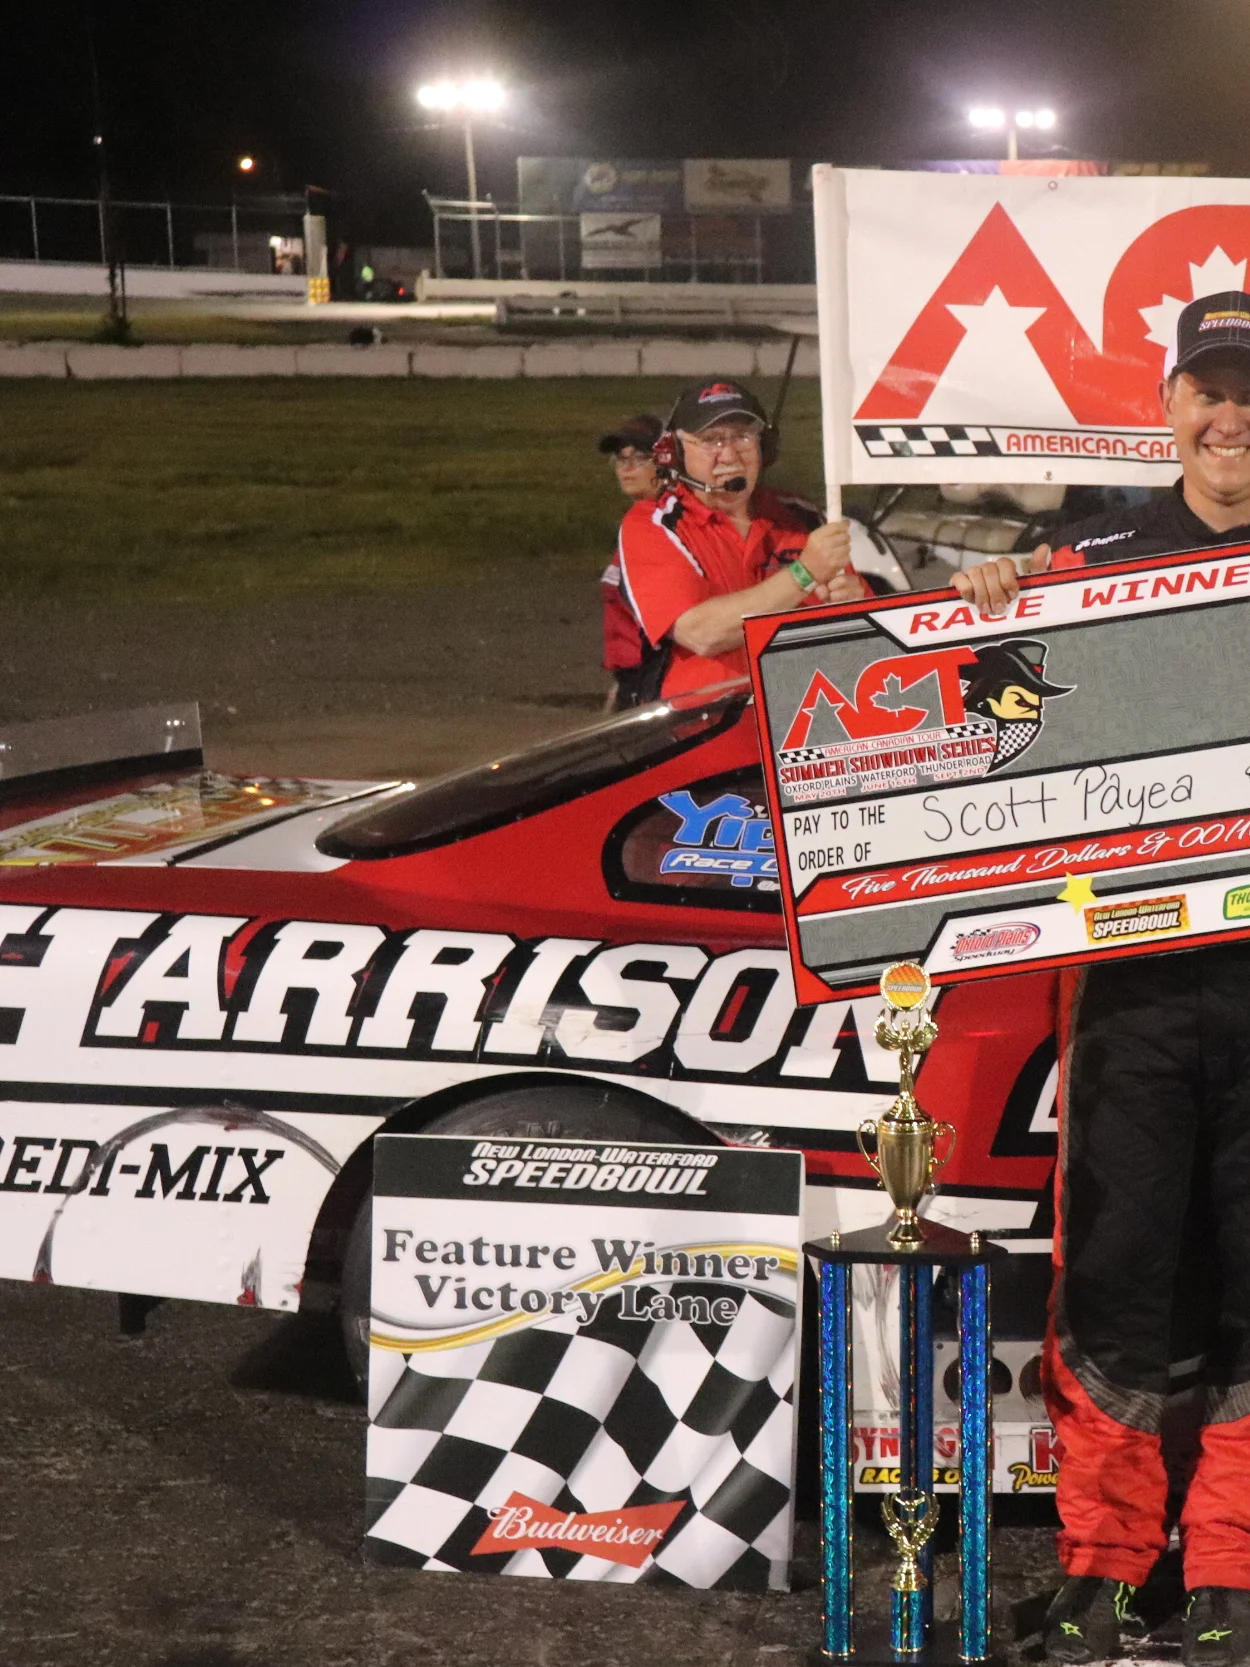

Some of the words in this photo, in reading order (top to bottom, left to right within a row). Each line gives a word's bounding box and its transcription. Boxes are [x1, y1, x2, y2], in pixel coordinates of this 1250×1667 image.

[1006, 432, 1179, 459] AMERICAN-CAN
[1091, 530, 1137, 546] IMPACT
[780, 646, 980, 751] ACT
[915, 731, 942, 742] TOUR
[780, 759, 847, 784] SUMMER
[850, 746, 938, 773] SHOWDOWN
[941, 736, 999, 760] SERIES
[920, 760, 964, 775] THUNDER
[965, 756, 992, 768] ROAD
[963, 767, 986, 777] 2ND
[785, 780, 823, 795] OXFORD
[824, 776, 857, 790] PLAINS
[860, 767, 916, 783] WATERFORD
[861, 782, 888, 792] JUNE
[891, 777, 916, 787] 16TH
[794, 791, 818, 802] MAY
[820, 788, 847, 799] 20TH
[922, 778, 1058, 842] Scott
[1075, 764, 1194, 830] Payea
[793, 815, 822, 836] PAY
[831, 811, 849, 830] TO
[859, 805, 886, 826] THE
[669, 853, 754, 870] Race
[798, 846, 845, 871] ORDER
[854, 842, 872, 863] OF
[841, 871, 898, 902] Five
[901, 853, 1022, 893] Thousand
[1026, 838, 1131, 875] Dollars
[1092, 911, 1180, 939] SPEEDBOWL
[471, 1141, 522, 1160] NEW
[523, 1143, 719, 1168] LONDON-WATERFORD
[463, 1159, 710, 1195] SPEEDBOWL
[381, 1228, 577, 1271] Feature
[591, 1237, 781, 1282] Winner
[414, 1274, 605, 1326] Victory
[618, 1284, 739, 1326] Lane
[488, 1505, 664, 1547] Budweiser
